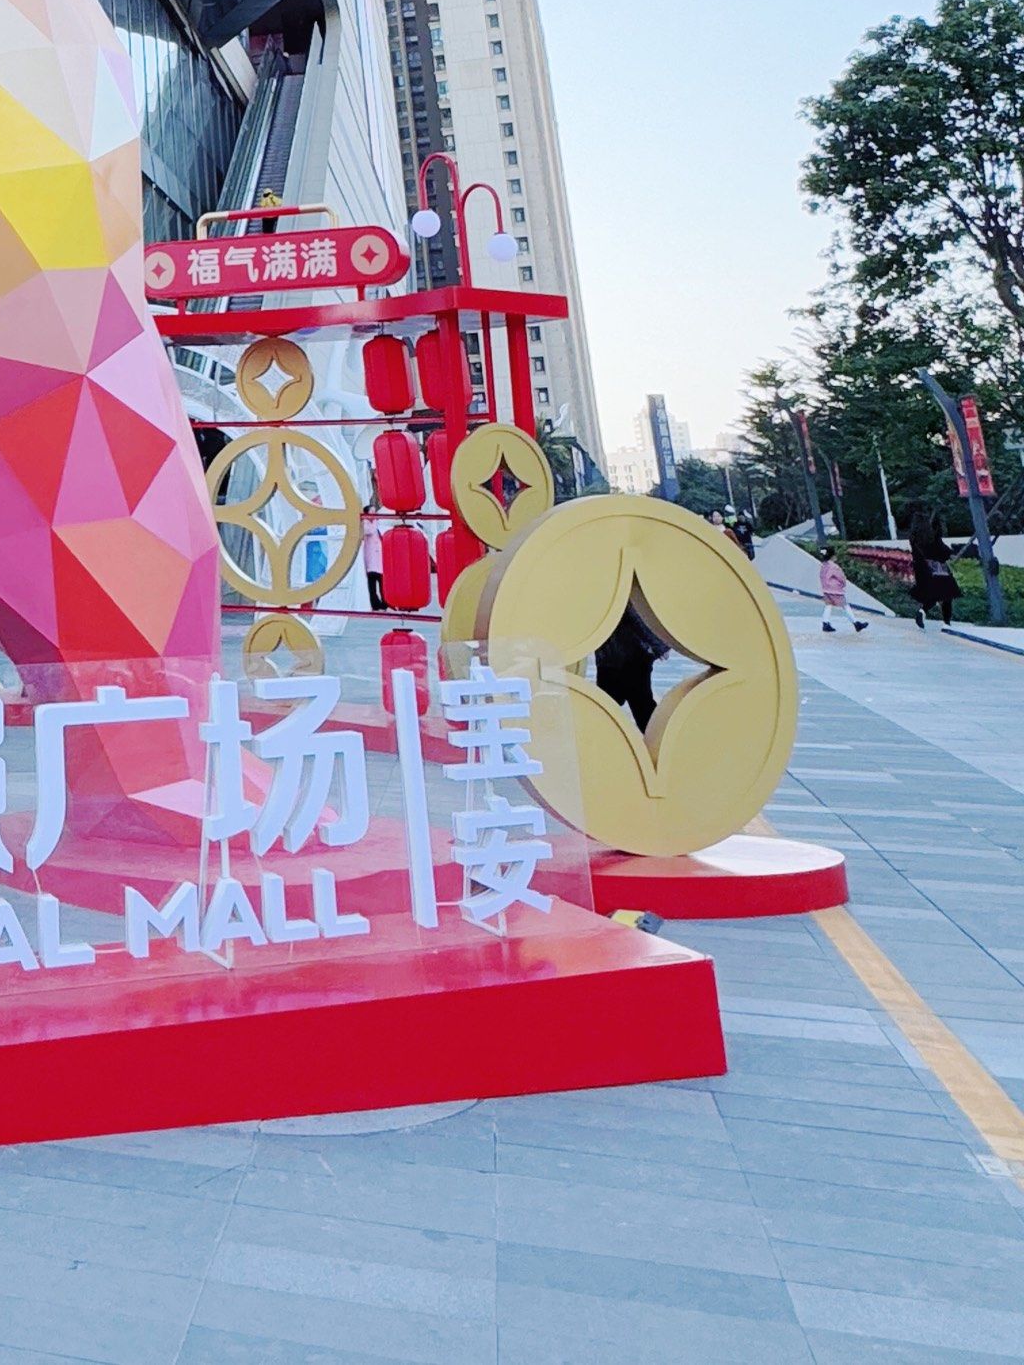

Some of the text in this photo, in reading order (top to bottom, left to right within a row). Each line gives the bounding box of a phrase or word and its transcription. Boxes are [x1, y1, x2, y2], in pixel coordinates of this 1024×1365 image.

[187, 238, 338, 285] 福气满满
[440, 657, 556, 922] 宝安
[124, 867, 371, 959] MALL
